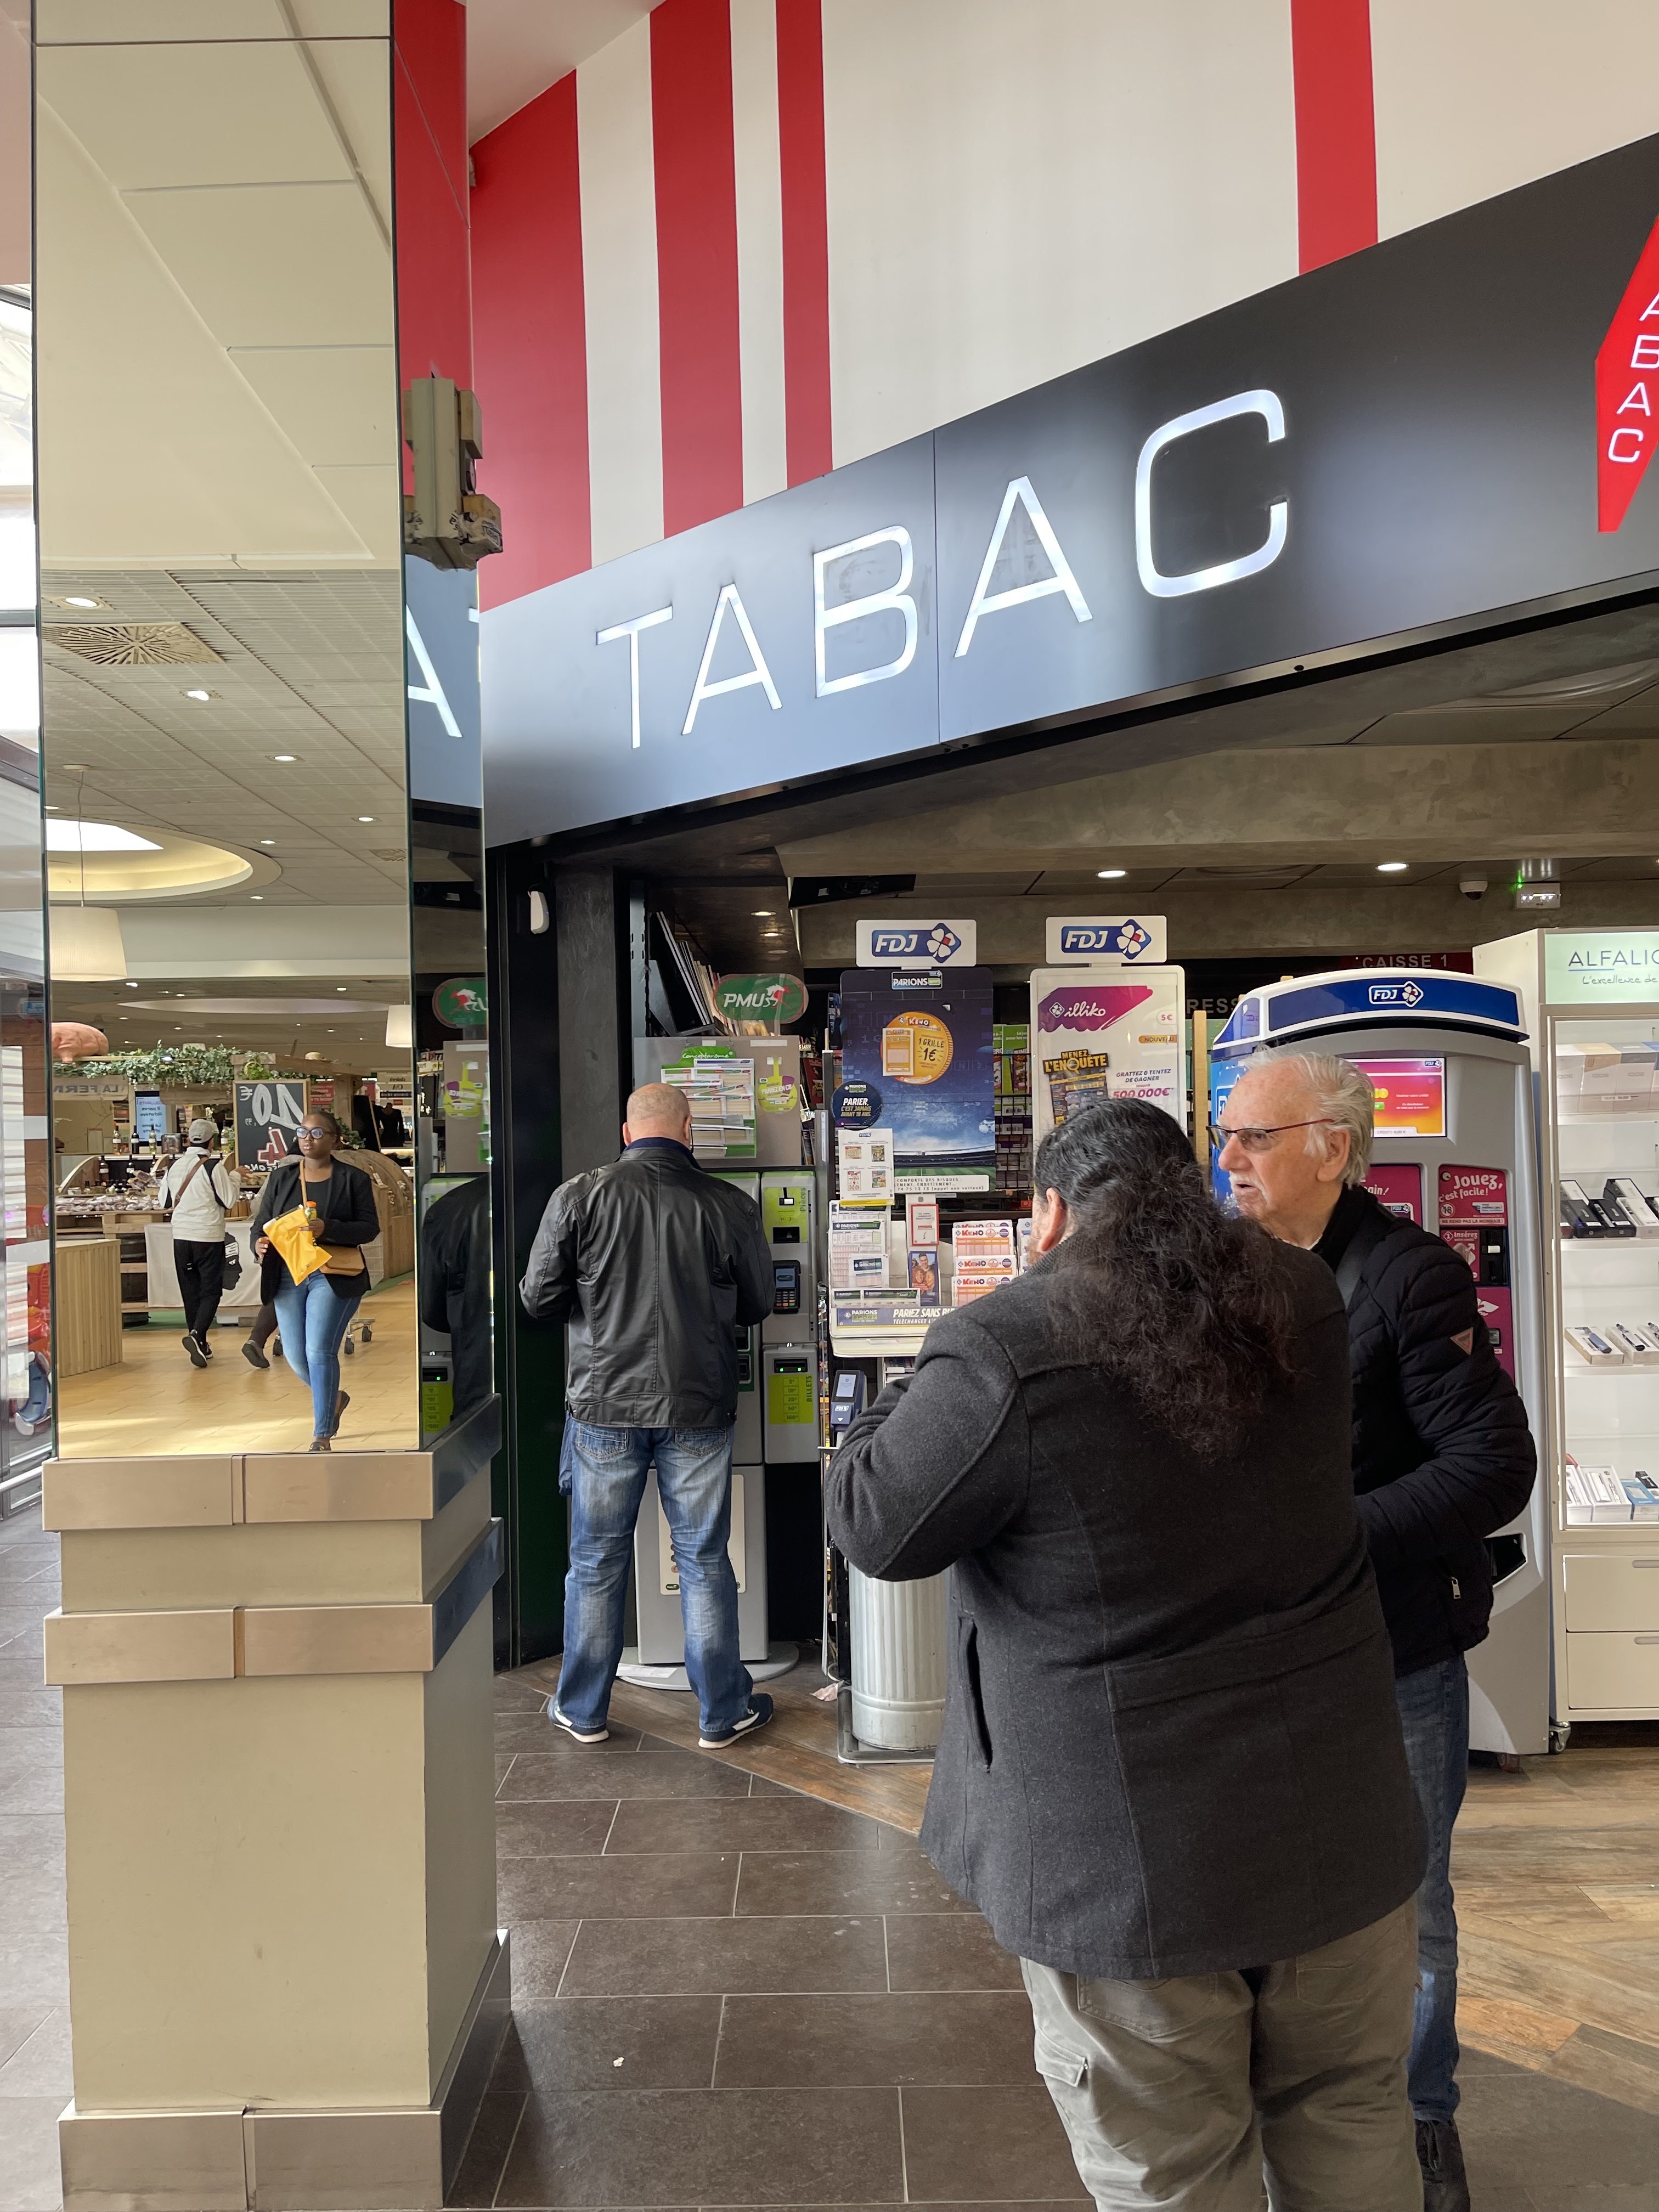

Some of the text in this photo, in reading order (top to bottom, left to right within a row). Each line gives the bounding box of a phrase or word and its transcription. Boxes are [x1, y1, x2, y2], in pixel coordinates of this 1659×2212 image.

[596, 388, 1289, 749] TABAC
[875, 934, 918, 952] FDJ
[1065, 930, 1108, 949] FDJ
[1362, 955, 1448, 969] CAISSE 1
[893, 978, 928, 986] PARIONS
[1582, 974, 1658, 984] L'excellence de
[1373, 989, 1397, 1000] FDJ
[724, 993, 765, 1008] PMU
[1064, 1001, 1105, 1017] illiko
[908, 1017, 930, 1026] KENO
[923, 1038, 945, 1048] GRILLE
[923, 1047, 937, 1062] 1€
[1062, 1051, 1088, 1059] MENEZ
[1045, 1054, 1107, 1075] L'ENQUÊTE
[761, 1086, 778, 1094] PARIEZ
[843, 1098, 869, 1106] PARIER,
[1454, 1174, 1503, 1190] Jouez,
[1364, 1184, 1390, 1195] ain!
[1438, 1187, 1488, 1203] c'est facile!
[1454, 1231, 1478, 1239] Insérez
[893, 1308, 921, 1318] PARIEZ
[918, 1308, 941, 1318] SANS
